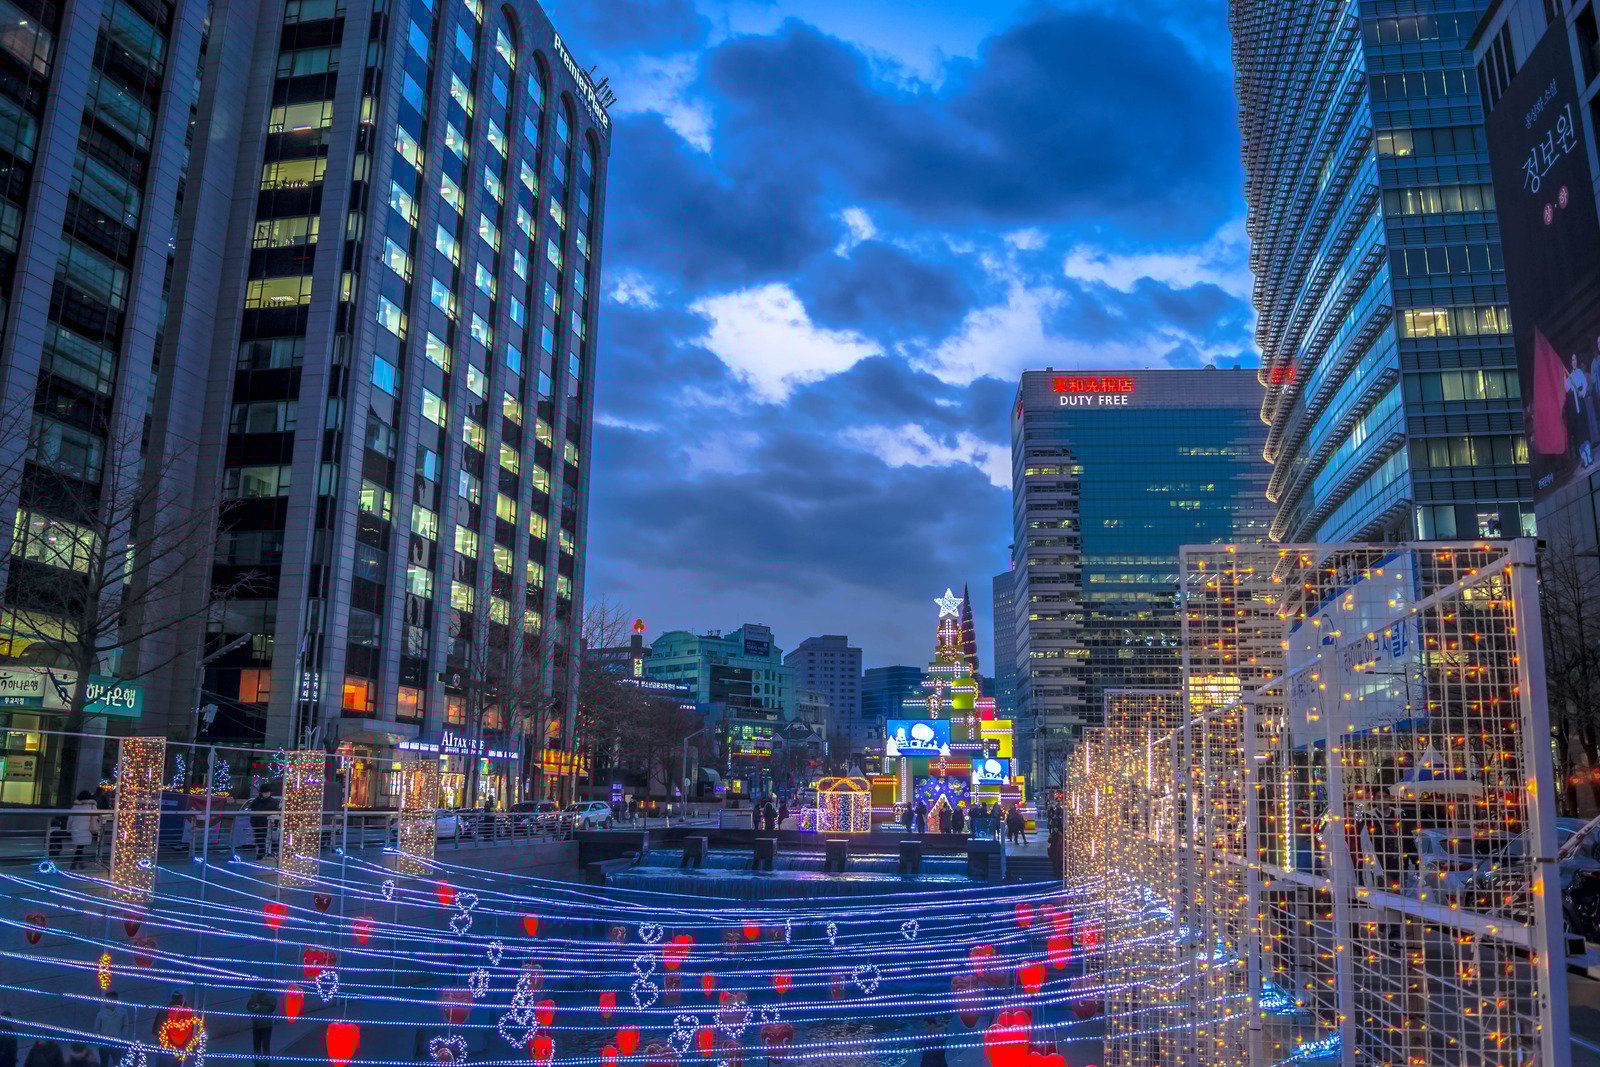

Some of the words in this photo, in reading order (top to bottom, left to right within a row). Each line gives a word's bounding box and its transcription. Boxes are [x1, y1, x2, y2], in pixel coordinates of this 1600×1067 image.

[554, 32, 589, 95] Premier
[587, 89, 608, 129] Place
[1522, 103, 1578, 194] 정보원
[1060, 396, 1092, 406] DUTY
[1099, 395, 1128, 405] FREE
[8, 679, 39, 692] 하나은행
[86, 683, 136, 709] 하나은행
[441, 730, 453, 747] A1
[453, 737, 467, 748] TAX
[468, 739, 485, 750] RE
